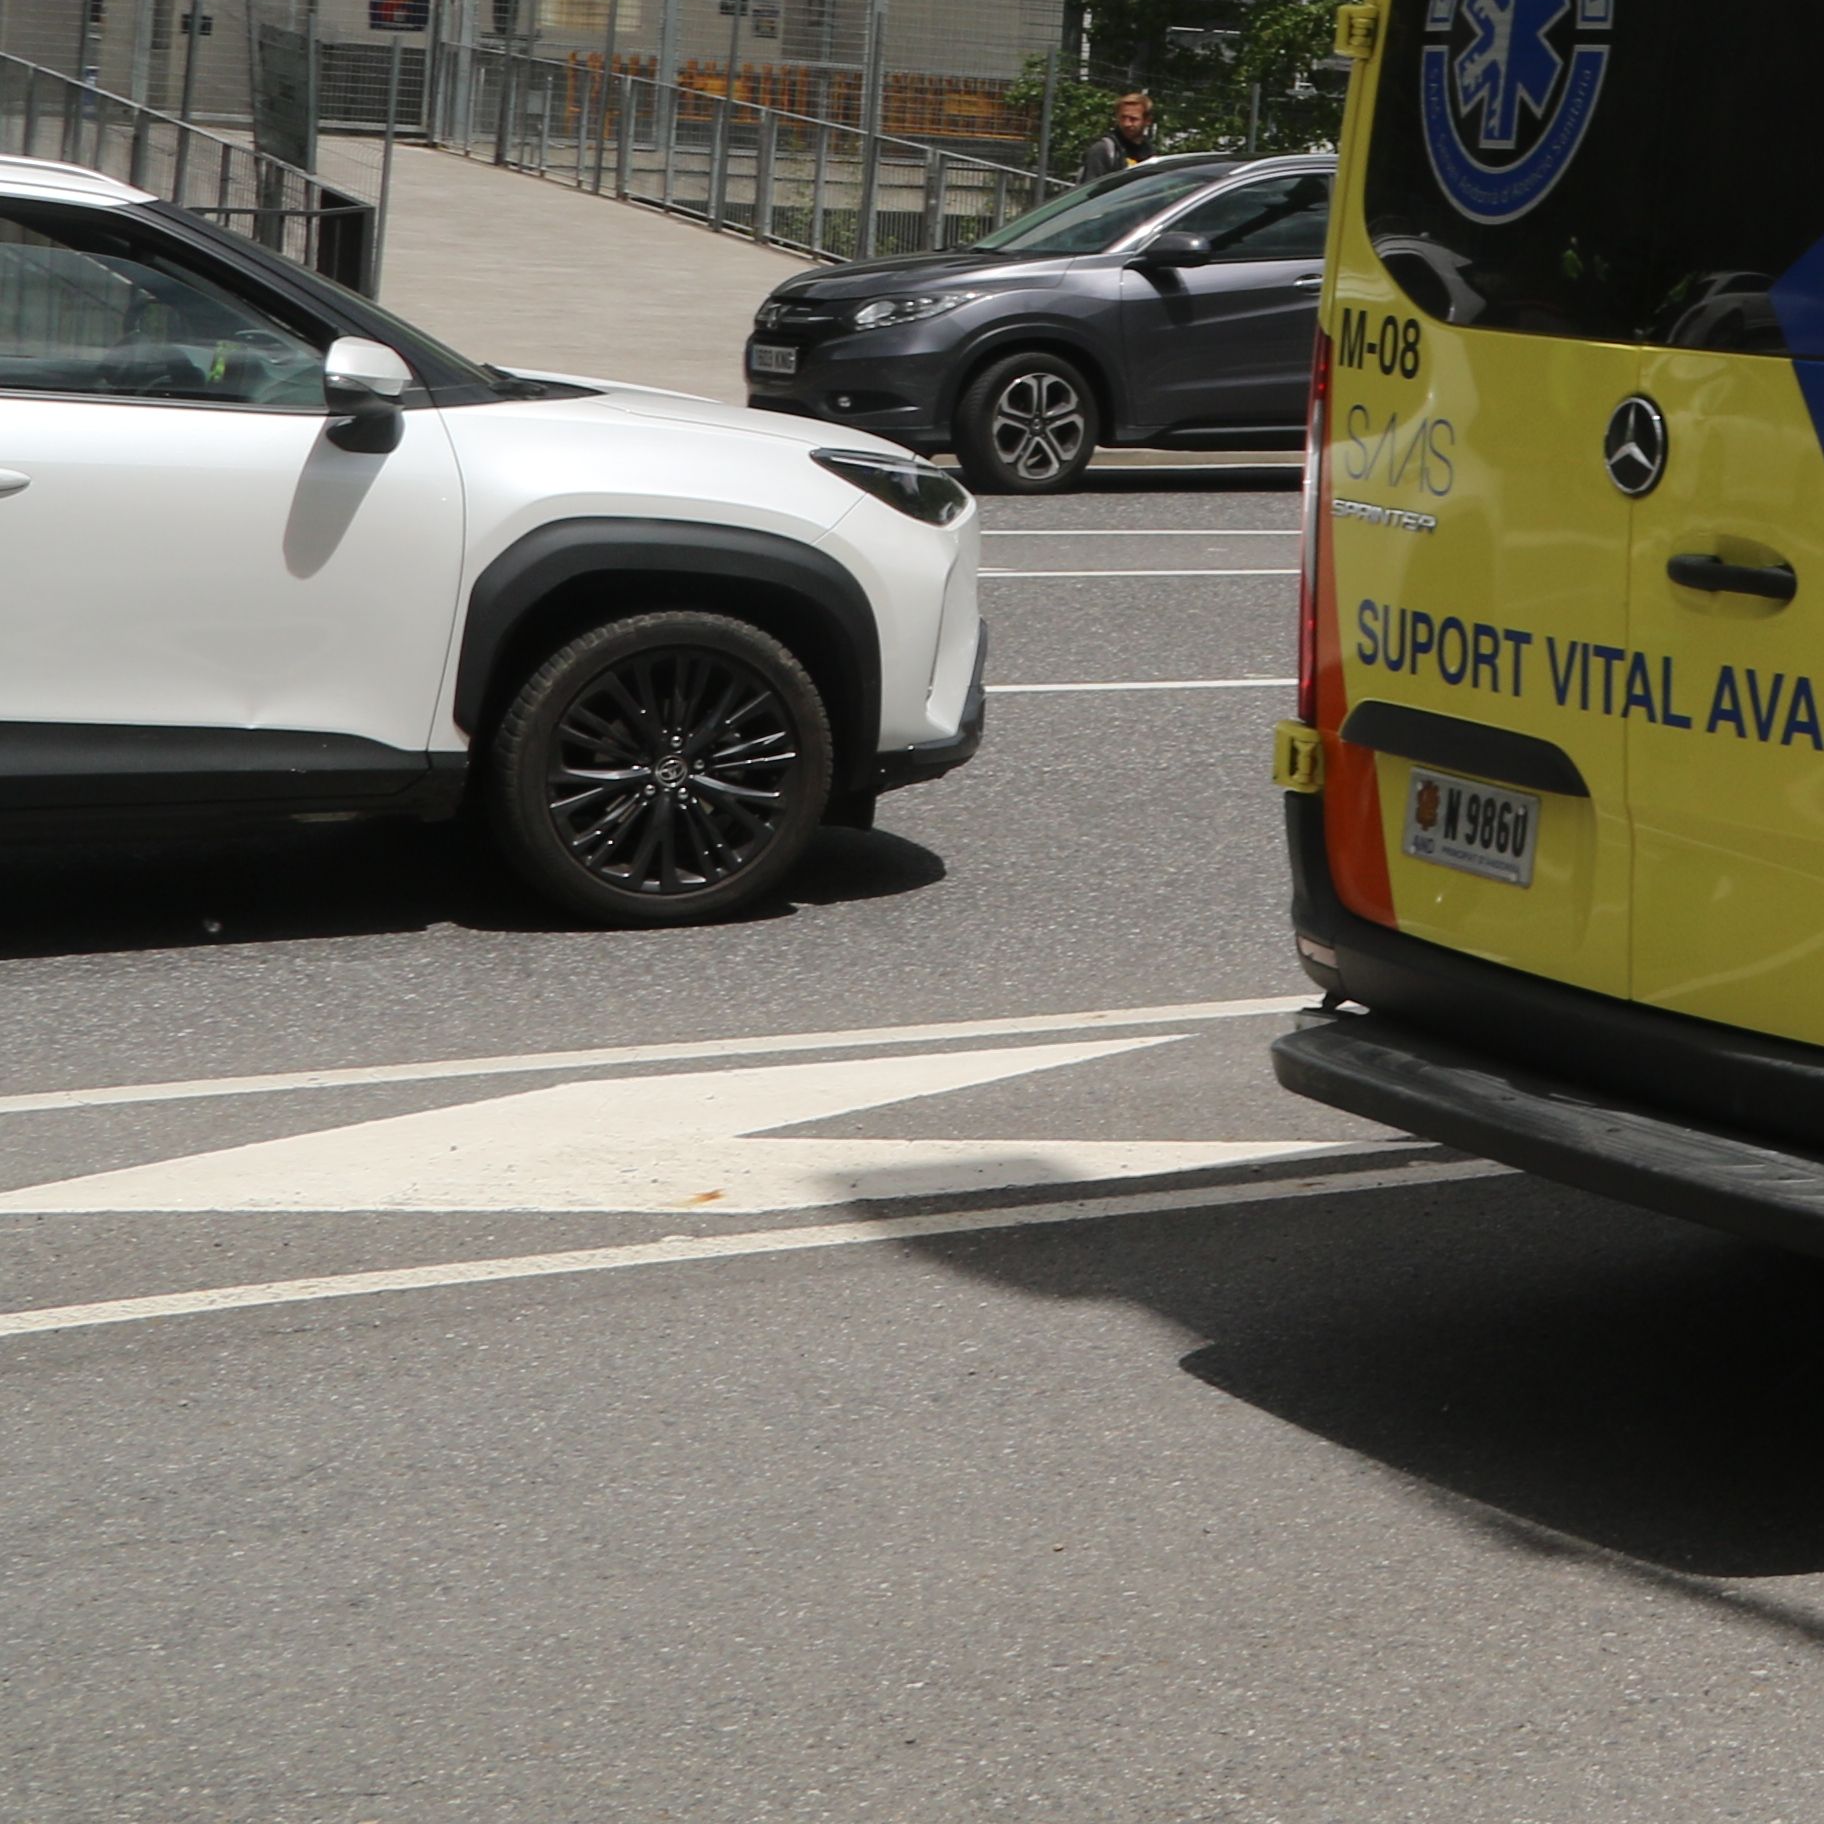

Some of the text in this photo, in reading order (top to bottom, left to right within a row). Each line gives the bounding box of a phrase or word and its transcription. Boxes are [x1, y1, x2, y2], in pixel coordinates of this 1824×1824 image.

[1338, 307, 1421, 380] M-08
[1330, 497, 1437, 535] SPRINTER
[1357, 599, 1532, 697] SUPORT
[1547, 636, 1692, 730] VITAL
[1465, 793, 1528, 858] 9860
